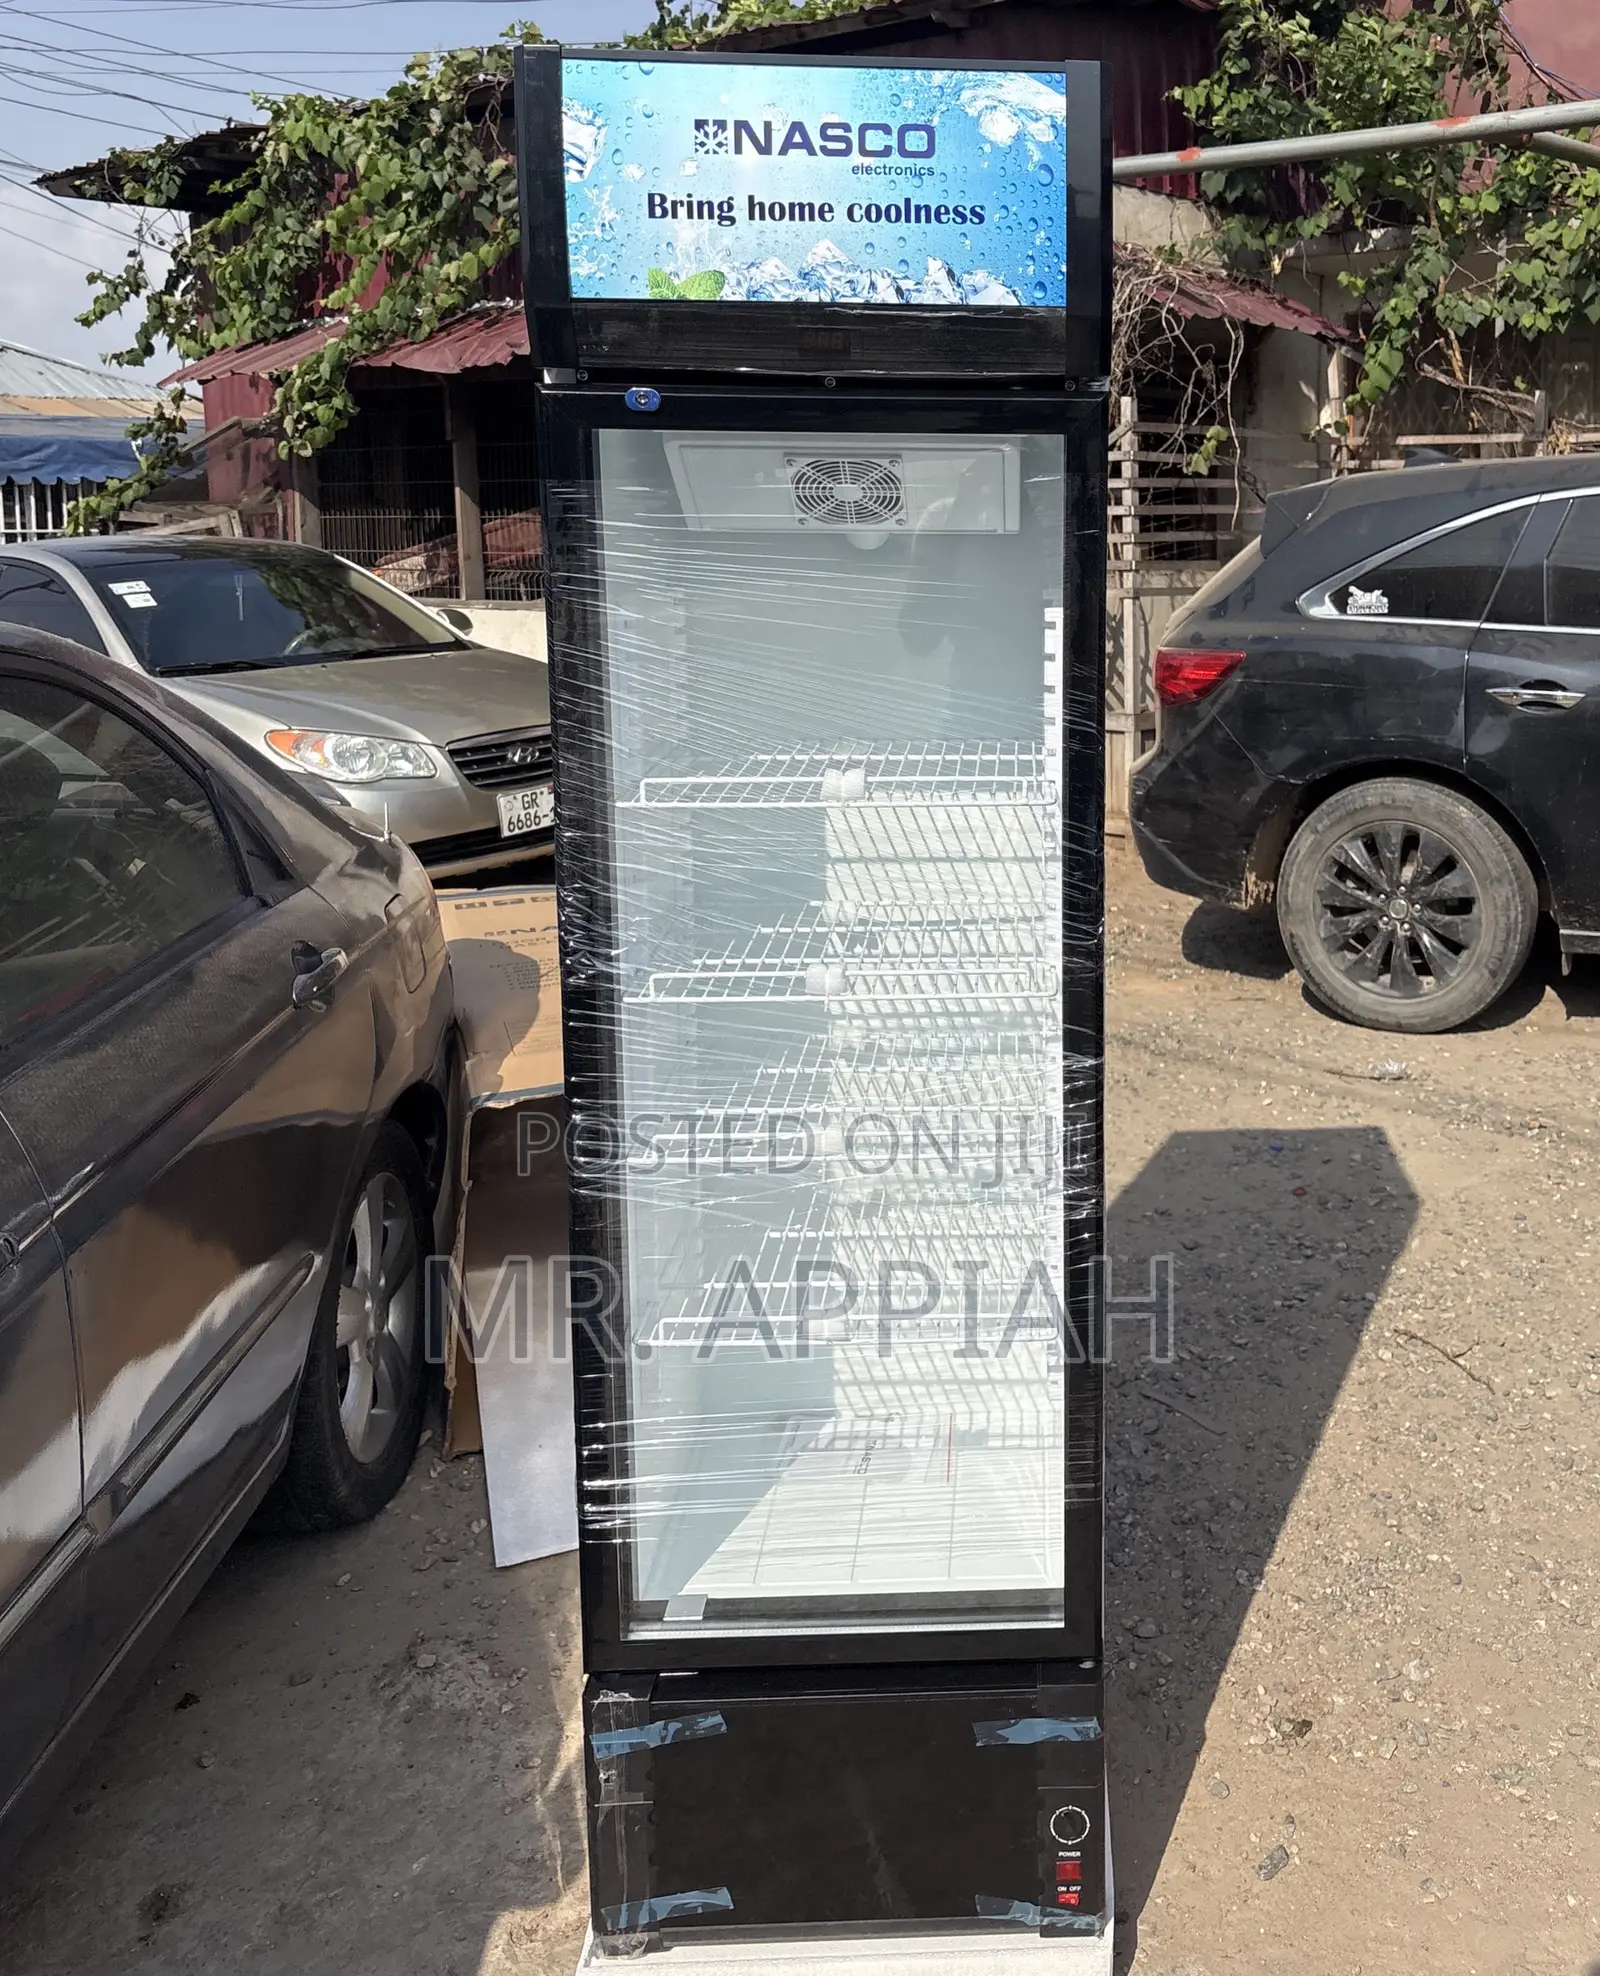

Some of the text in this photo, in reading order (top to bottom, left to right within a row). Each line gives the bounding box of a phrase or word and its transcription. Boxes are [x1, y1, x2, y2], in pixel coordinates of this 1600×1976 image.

[734, 119, 936, 158] NASCO
[851, 162, 935, 177] electronics
[647, 192, 986, 227] Bring home coolness
[521, 791, 539, 811] GR
